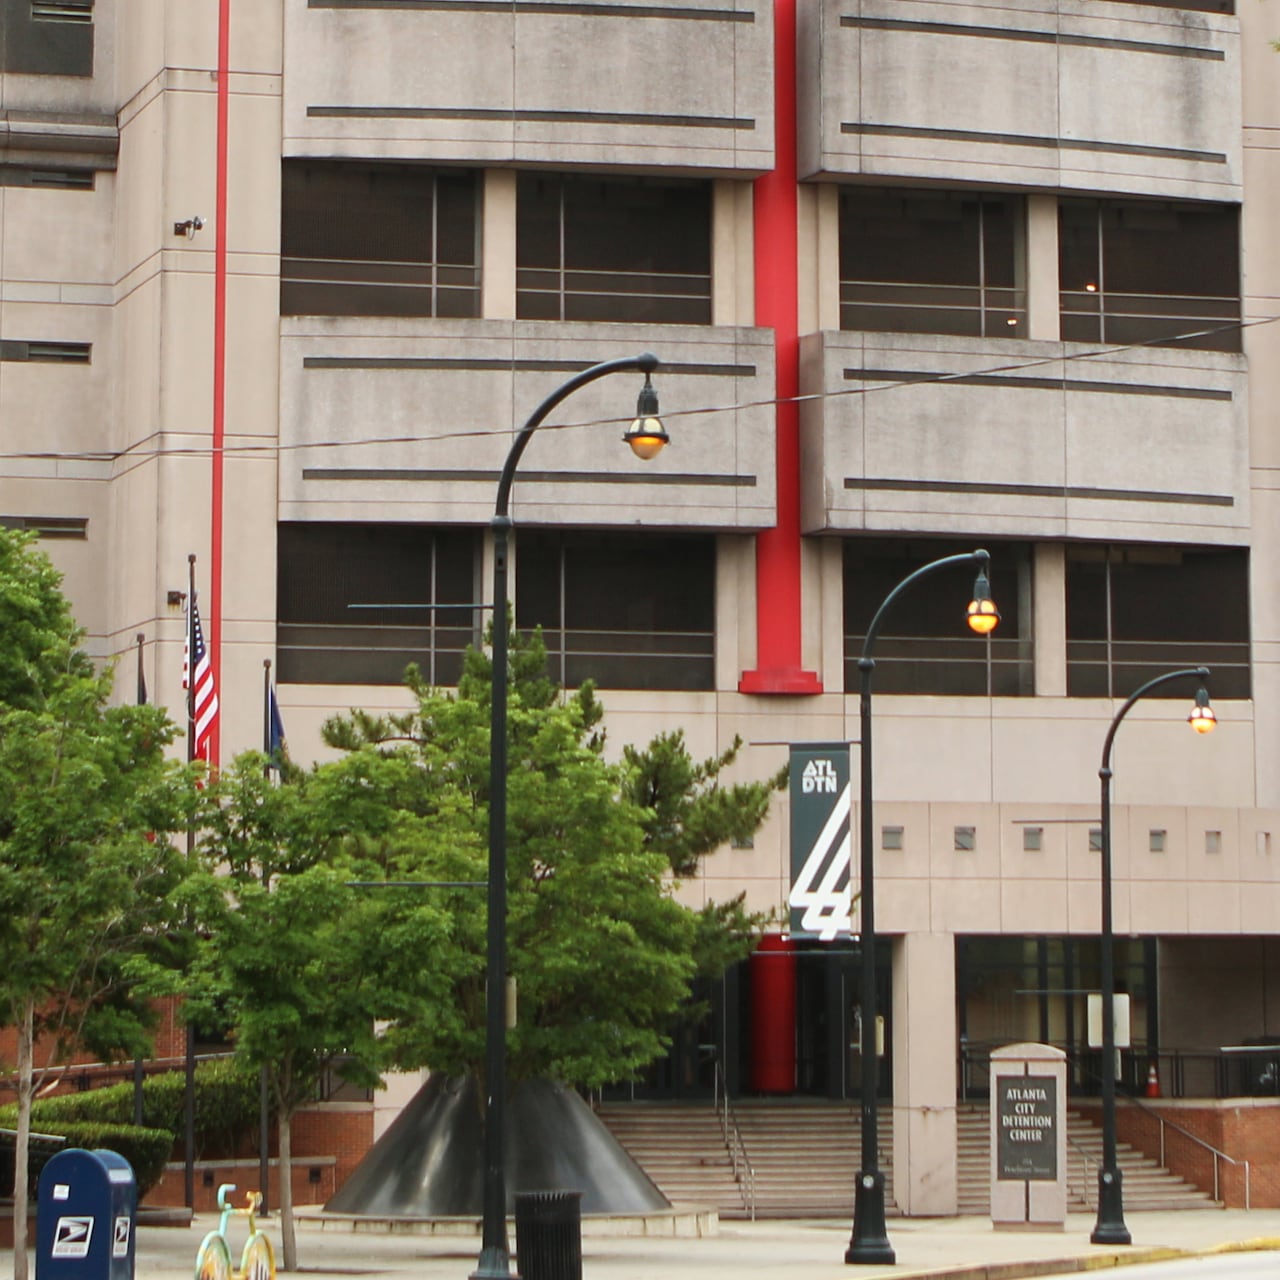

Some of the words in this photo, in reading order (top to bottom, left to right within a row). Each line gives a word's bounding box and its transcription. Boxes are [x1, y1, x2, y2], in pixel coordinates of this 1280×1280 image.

[802, 759, 837, 777] ATL
[802, 776, 838, 793] DTN
[1006, 1088, 1047, 1100] ATLANTA
[1014, 1102, 1036, 1114] CITY
[1002, 1115, 1052, 1127] DETENTION
[1009, 1129, 1042, 1141] CENTER
